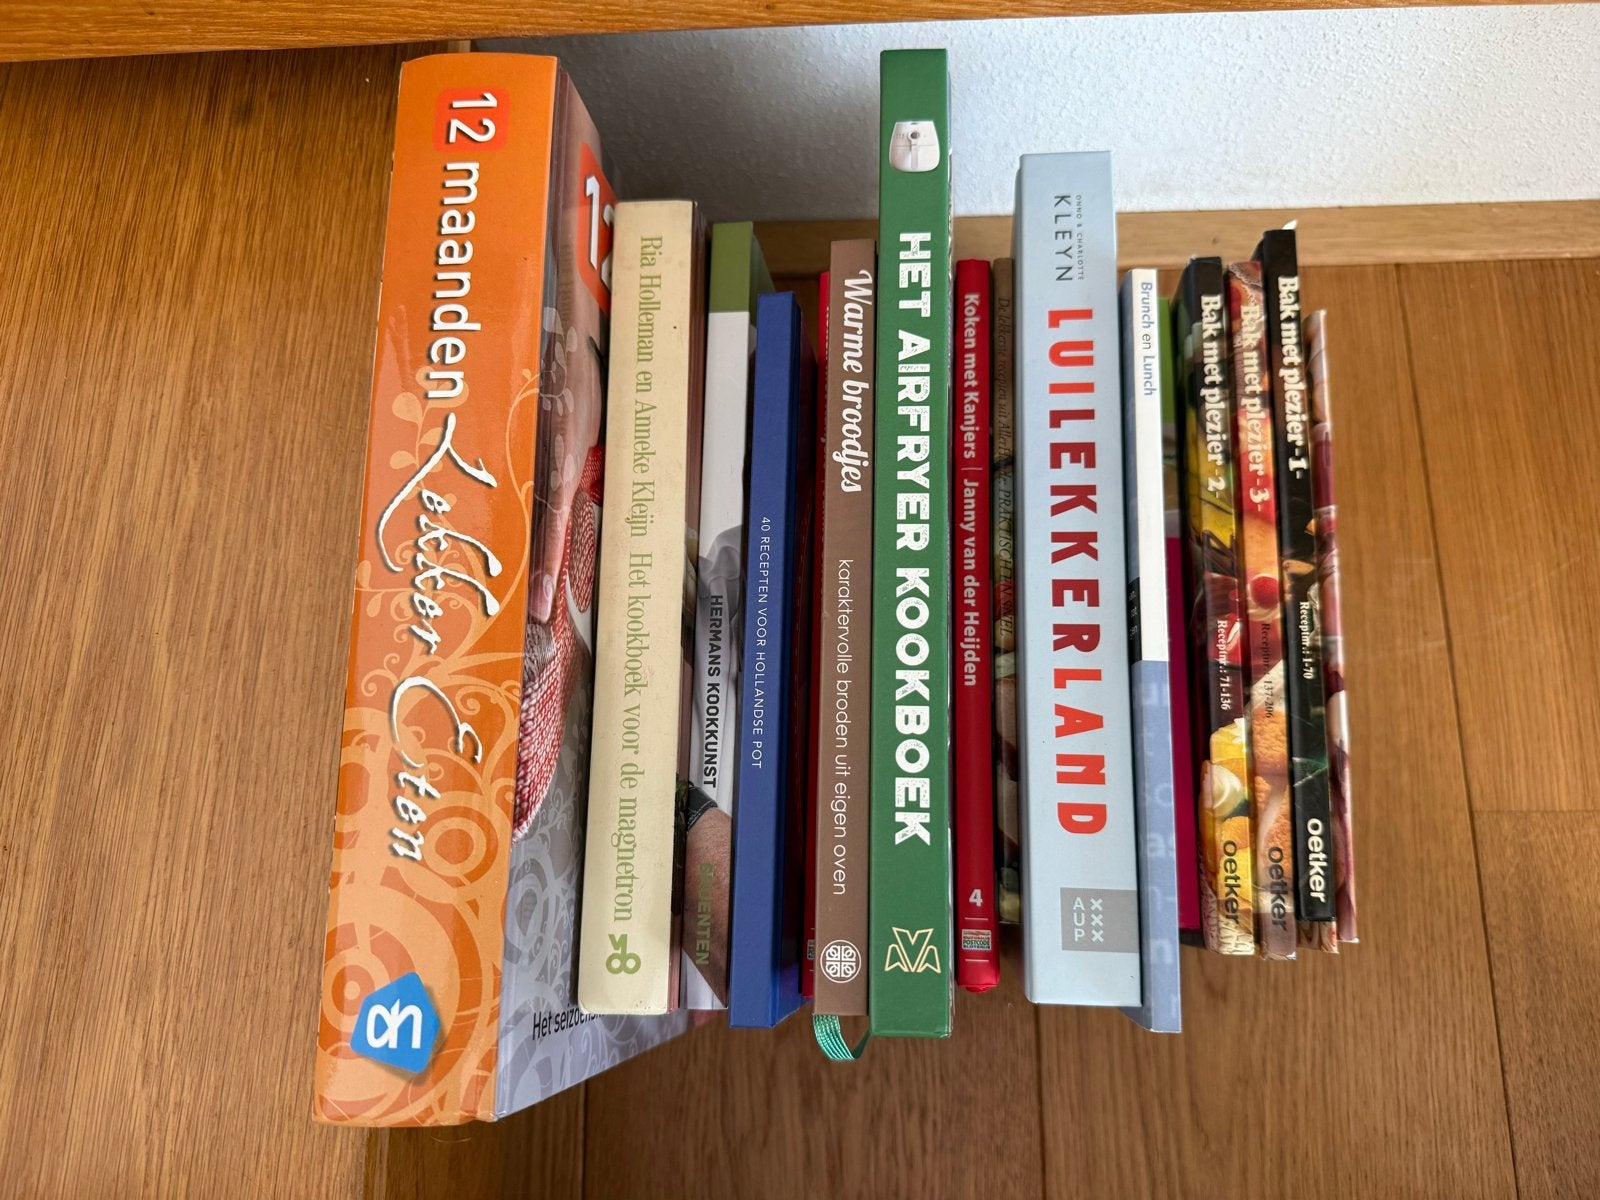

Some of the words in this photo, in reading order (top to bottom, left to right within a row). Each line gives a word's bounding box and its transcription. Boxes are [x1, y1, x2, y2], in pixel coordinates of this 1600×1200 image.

[449, 92, 498, 143] 12
[640, 235, 663, 267] Ria
[1054, 195, 1073, 281] KLEYN
[1076, 233, 1084, 281] CHARLOTTE
[428, 161, 481, 398] maanden
[898, 232, 931, 317] HET
[1277, 275, 1300, 320] Bak
[637, 274, 661, 363] Holleman
[843, 269, 873, 373] Warme
[963, 293, 980, 349] Koken
[1140, 281, 1155, 329] Brunch
[1200, 294, 1222, 338] Bak
[1240, 304, 1262, 348] Bak
[1142, 333, 1152, 350] en
[1203, 342, 1223, 384] met
[1280, 323, 1302, 365] met
[635, 370, 654, 393] en
[963, 356, 980, 387] met
[1143, 355, 1157, 396] Lunch
[1243, 352, 1264, 394] met
[960, 391, 980, 459] Kanjers
[1200, 387, 1228, 466] plezier
[1279, 368, 1309, 447] plezier
[633, 400, 657, 474] Anneke
[832, 380, 869, 493] broodjes
[896, 329, 931, 550] AIRFRYER
[1241, 398, 1269, 475] plezier
[625, 480, 655, 537] Kleijn
[762, 516, 771, 531] 40
[959, 479, 980, 533] Janny
[998, 488, 1013, 571] PRAKTISCH
[377, 412, 502, 655] Lekker
[963, 539, 976, 570] van
[628, 552, 653, 588] Het
[758, 537, 771, 603] RECEPTEN
[963, 575, 980, 607] der
[1048, 309, 1107, 834] LUILEKKERLAND
[707, 594, 724, 677] HERMANS
[756, 608, 767, 646] VOOR
[836, 559, 854, 674] karaktervolle
[1000, 598, 1014, 638] SNEL
[624, 594, 651, 697] kookboek
[960, 612, 981, 686] Heijden
[1302, 657, 1313, 680] 1-70
[753, 653, 766, 735] HOLLANDSE
[834, 680, 852, 748] broden
[895, 568, 931, 846] KOOKBOEK
[1219, 676, 1231, 711] 71-136
[1263, 680, 1275, 718] 137-206
[621, 704, 641, 755] voor
[703, 683, 720, 788] KOOKKUNST
[751, 741, 762, 768] POT
[391, 676, 483, 861] Eten
[620, 763, 645, 789] de
[834, 756, 851, 777] uit
[831, 781, 850, 839] eigen
[610, 797, 641, 922] magnetron
[833, 845, 847, 895] oven
[968, 888, 983, 907] 4
[532, 1012, 552, 1040] Het
